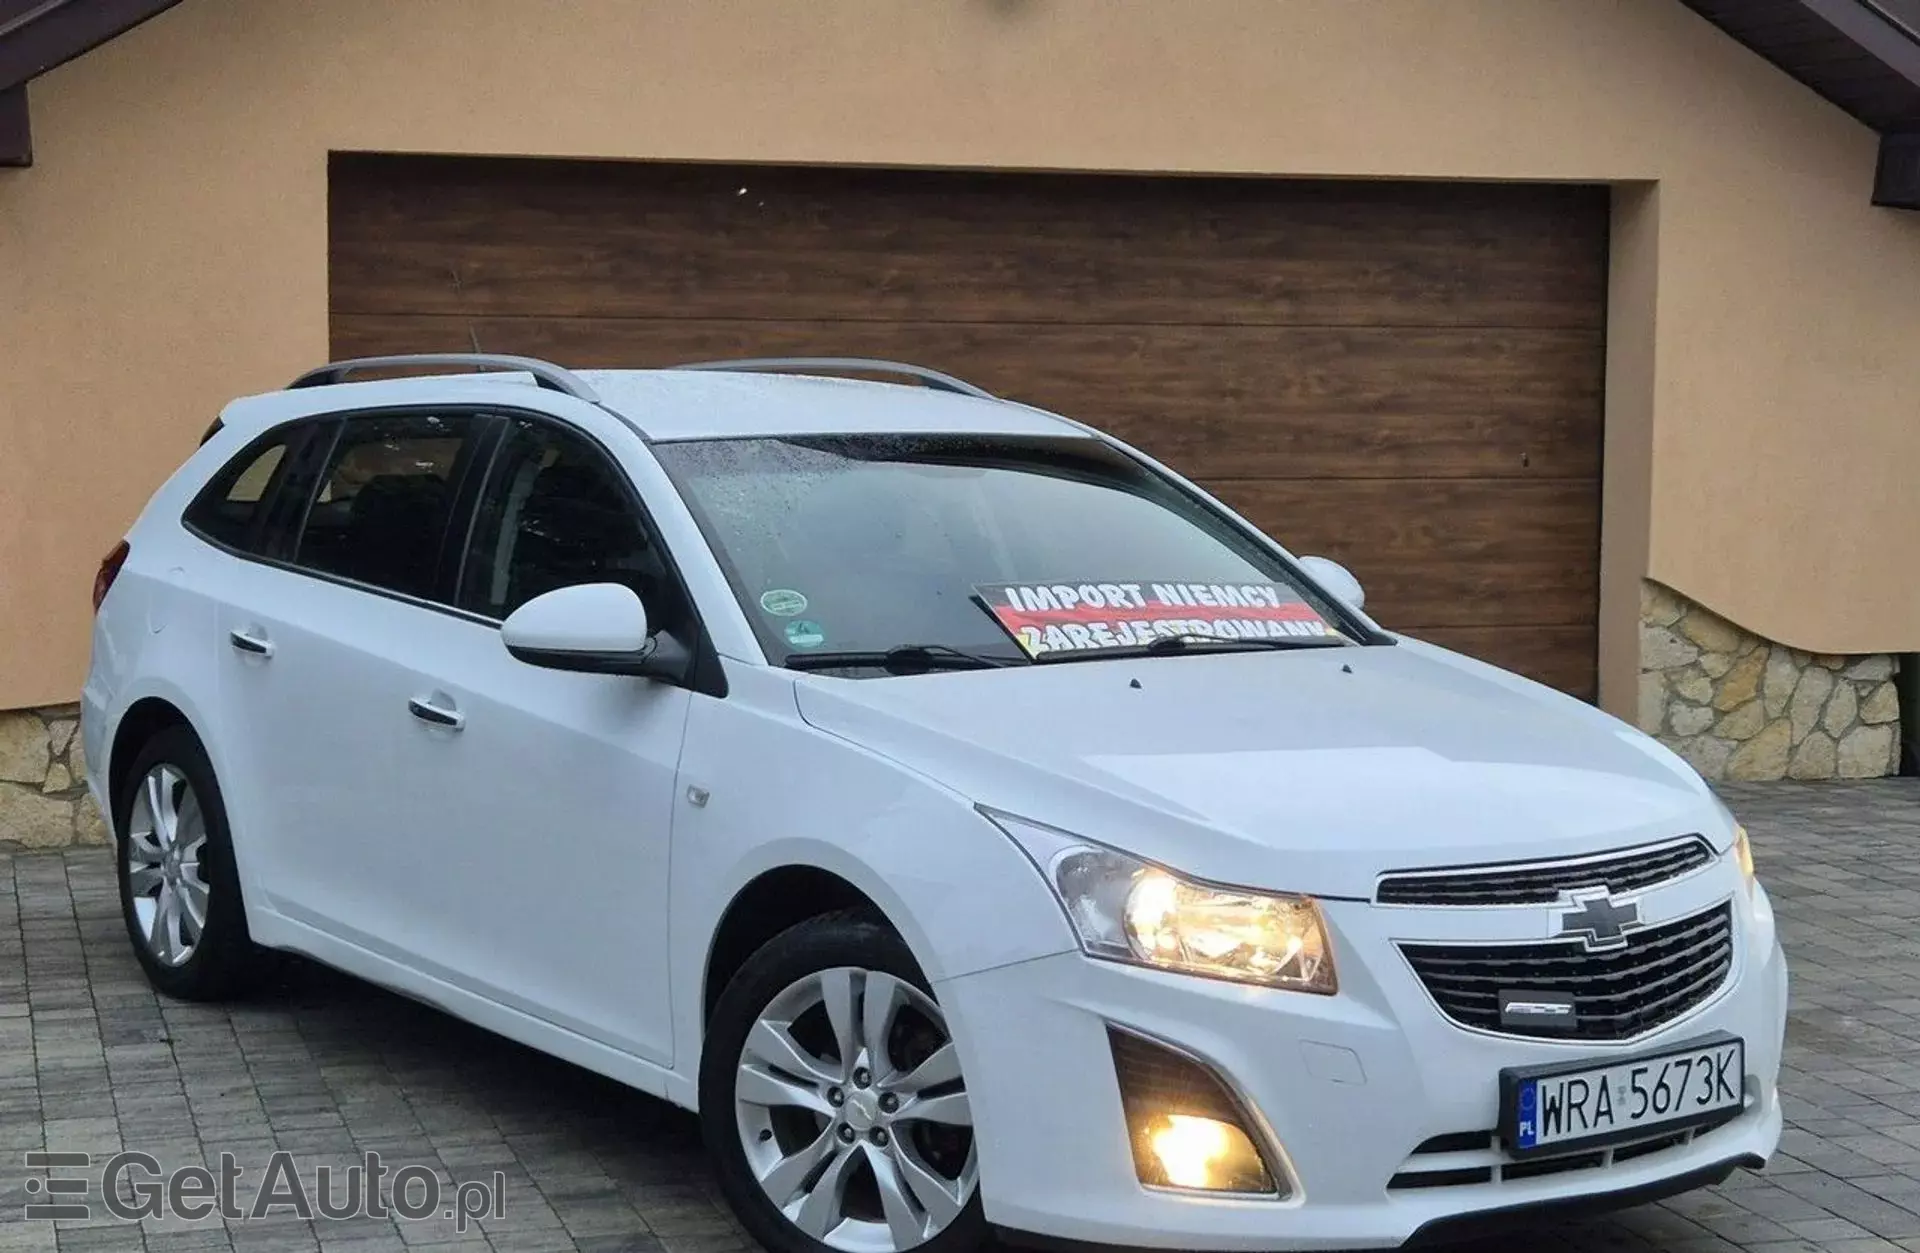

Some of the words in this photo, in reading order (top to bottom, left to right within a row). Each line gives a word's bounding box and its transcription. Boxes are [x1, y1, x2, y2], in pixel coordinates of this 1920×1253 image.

[1005, 584, 1144, 612] IMPORT
[1152, 584, 1279, 609] NIEMCY
[1541, 1075, 1614, 1137] WRA
[1630, 1048, 1736, 1119] 5673K
[1519, 1121, 1535, 1137] PL
